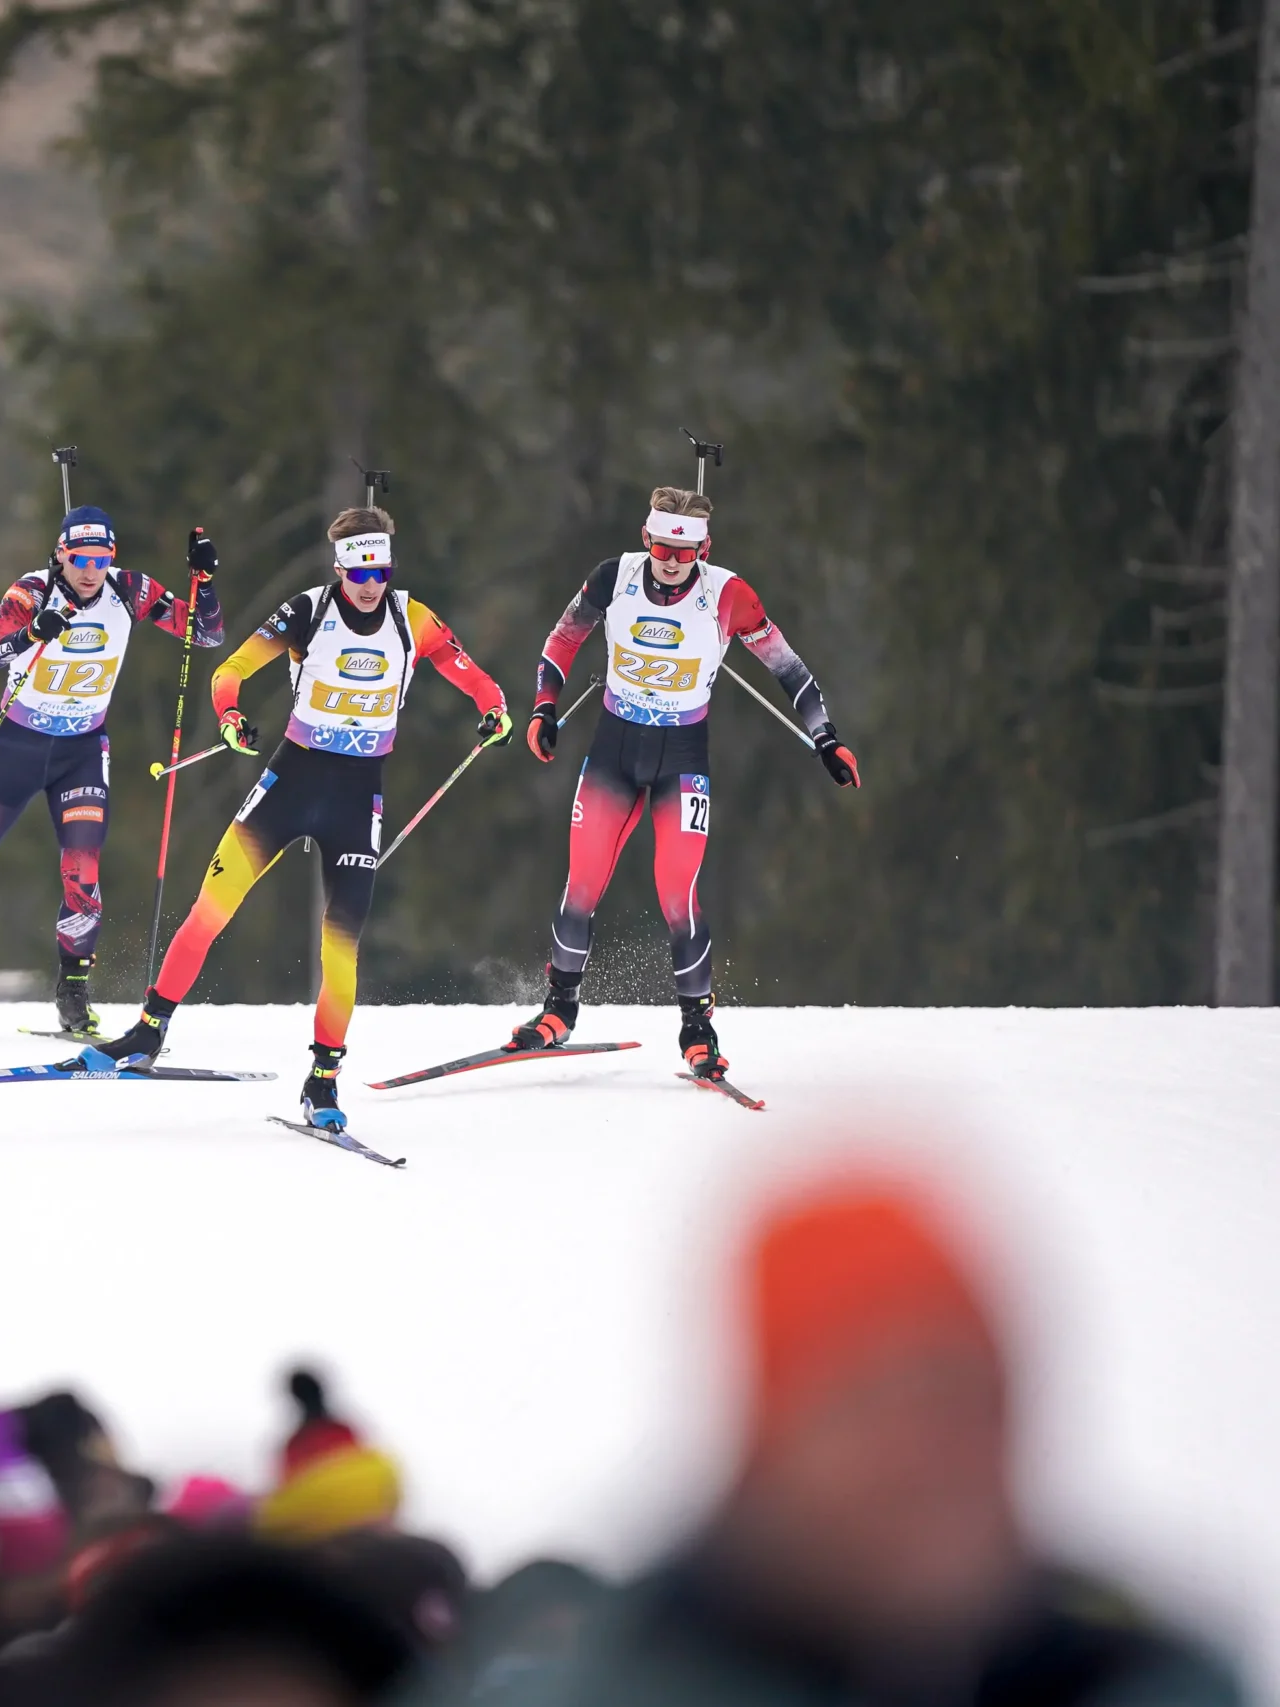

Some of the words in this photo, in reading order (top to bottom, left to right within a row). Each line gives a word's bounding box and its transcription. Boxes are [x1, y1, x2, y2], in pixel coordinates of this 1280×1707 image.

[47, 661, 104, 693] 12
[617, 652, 679, 687] 22
[324, 691, 381, 713] 14
[61, 715, 94, 733] X3
[343, 731, 380, 754] X3
[690, 796, 707, 832] 22
[70, 1070, 121, 1081] SALOMON
